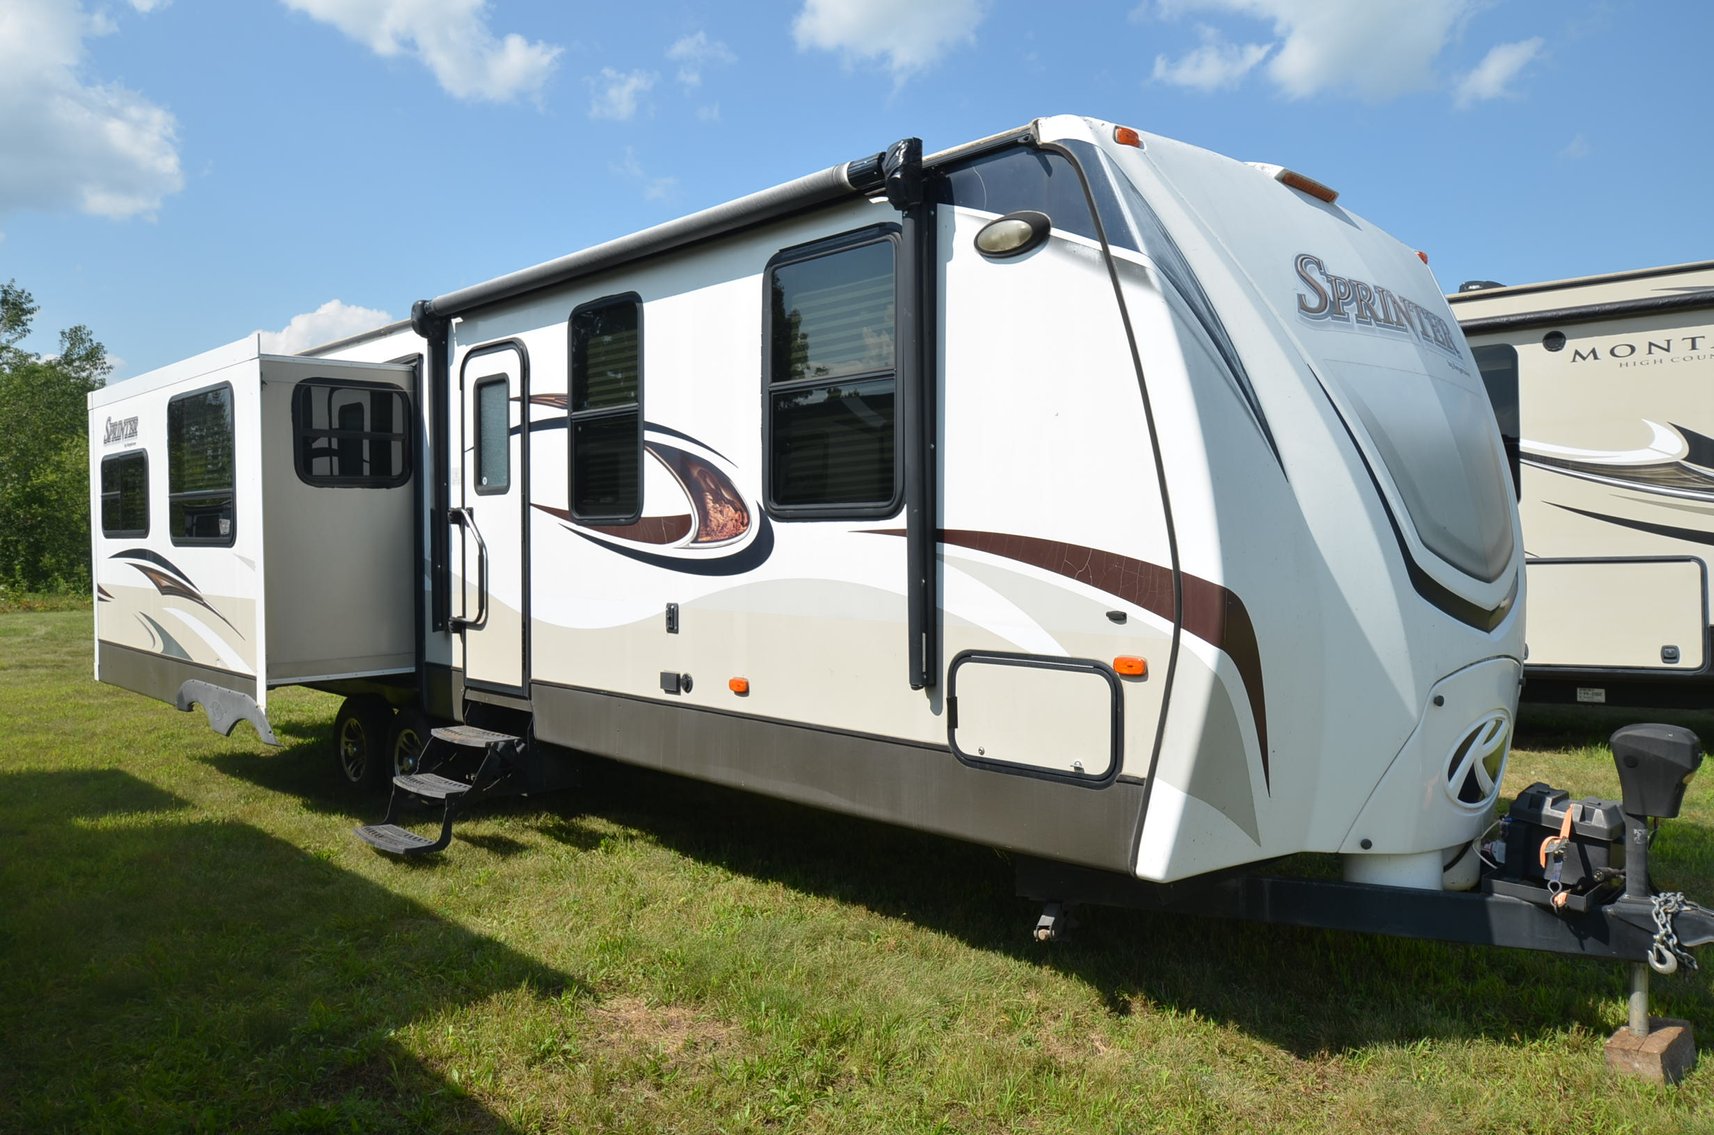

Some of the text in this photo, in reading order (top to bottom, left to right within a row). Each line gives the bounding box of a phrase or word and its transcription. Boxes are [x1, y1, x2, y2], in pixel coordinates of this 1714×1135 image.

[1295, 253, 1463, 360] SPRINTER
[1571, 335, 1714, 363] MONT
[1619, 358, 1663, 368] HIGH
[104, 416, 138, 445] SPRINTER
